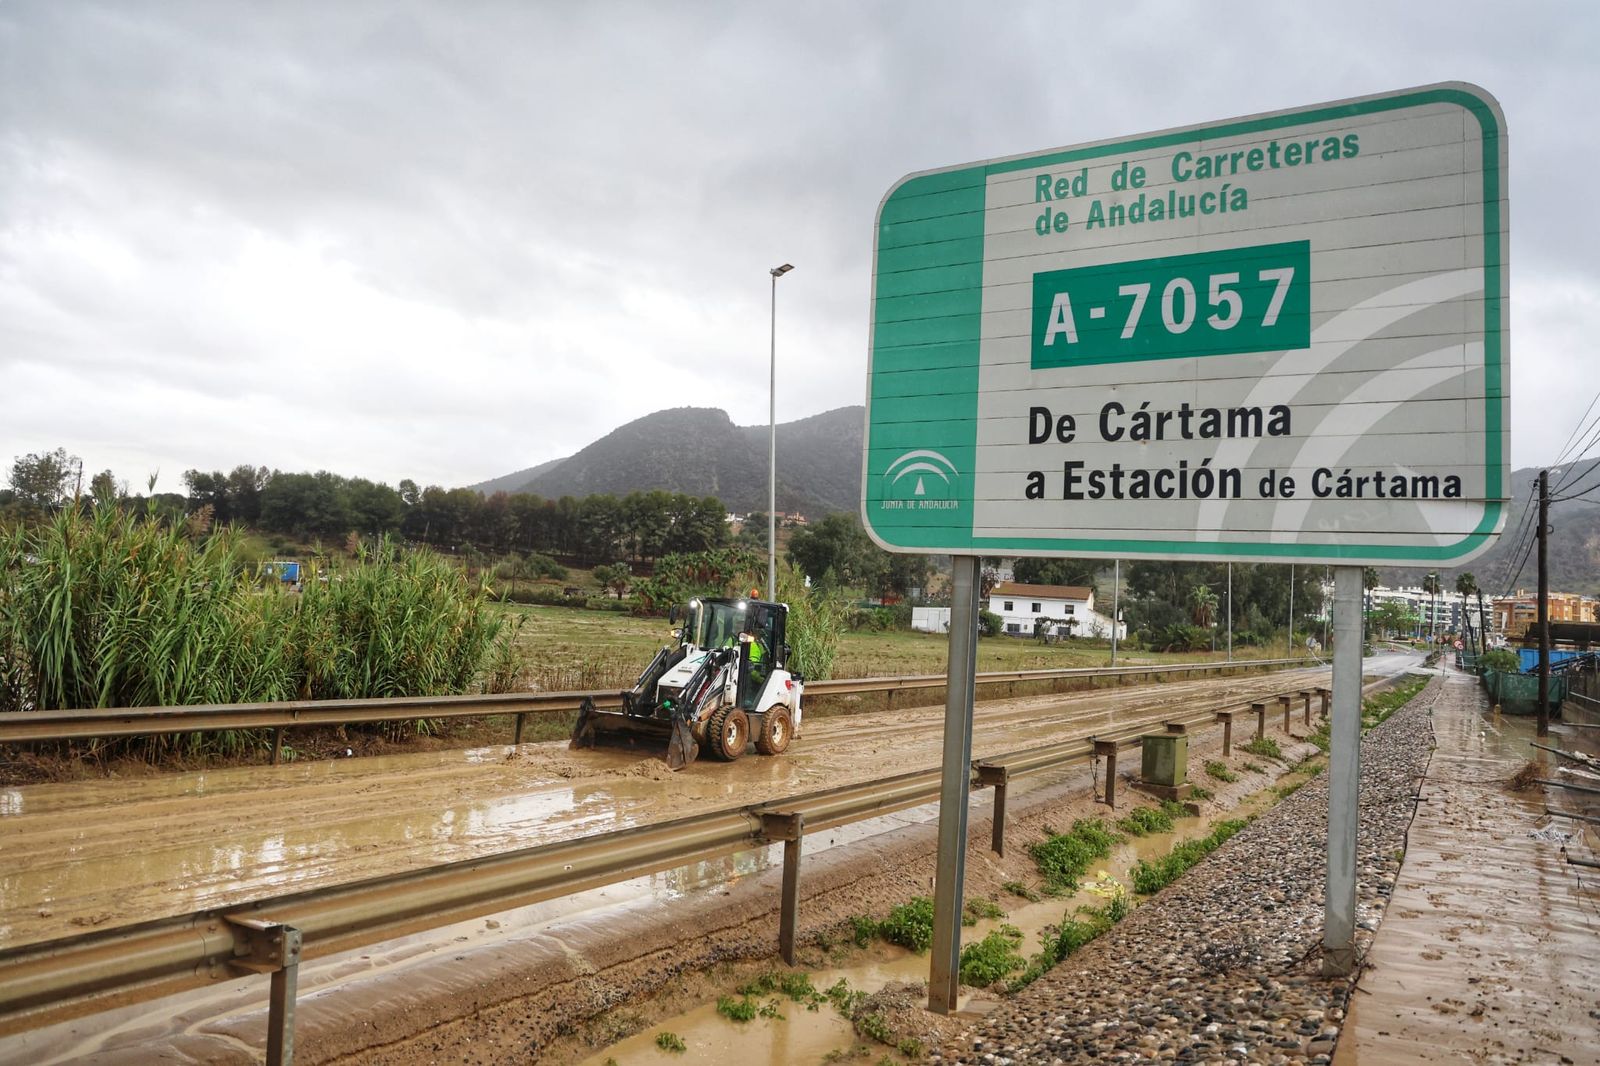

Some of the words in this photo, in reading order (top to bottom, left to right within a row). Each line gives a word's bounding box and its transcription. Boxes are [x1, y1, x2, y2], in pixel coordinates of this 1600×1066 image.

[1035, 167, 1088, 204] Red
[1111, 161, 1146, 191] de
[1171, 133, 1360, 182] Carreteras
[1035, 206, 1069, 236] de
[1086, 183, 1248, 230] Andalucía
[1043, 266, 1295, 346] A-7057
[1028, 405, 1076, 444] De
[1099, 401, 1292, 442] Cártama
[1025, 470, 1045, 500] a
[1063, 458, 1241, 500] Estación
[1258, 469, 1296, 498] de
[1311, 467, 1462, 498] Cártama
[881, 500, 904, 510] JUNTA
[907, 500, 915, 510] DE
